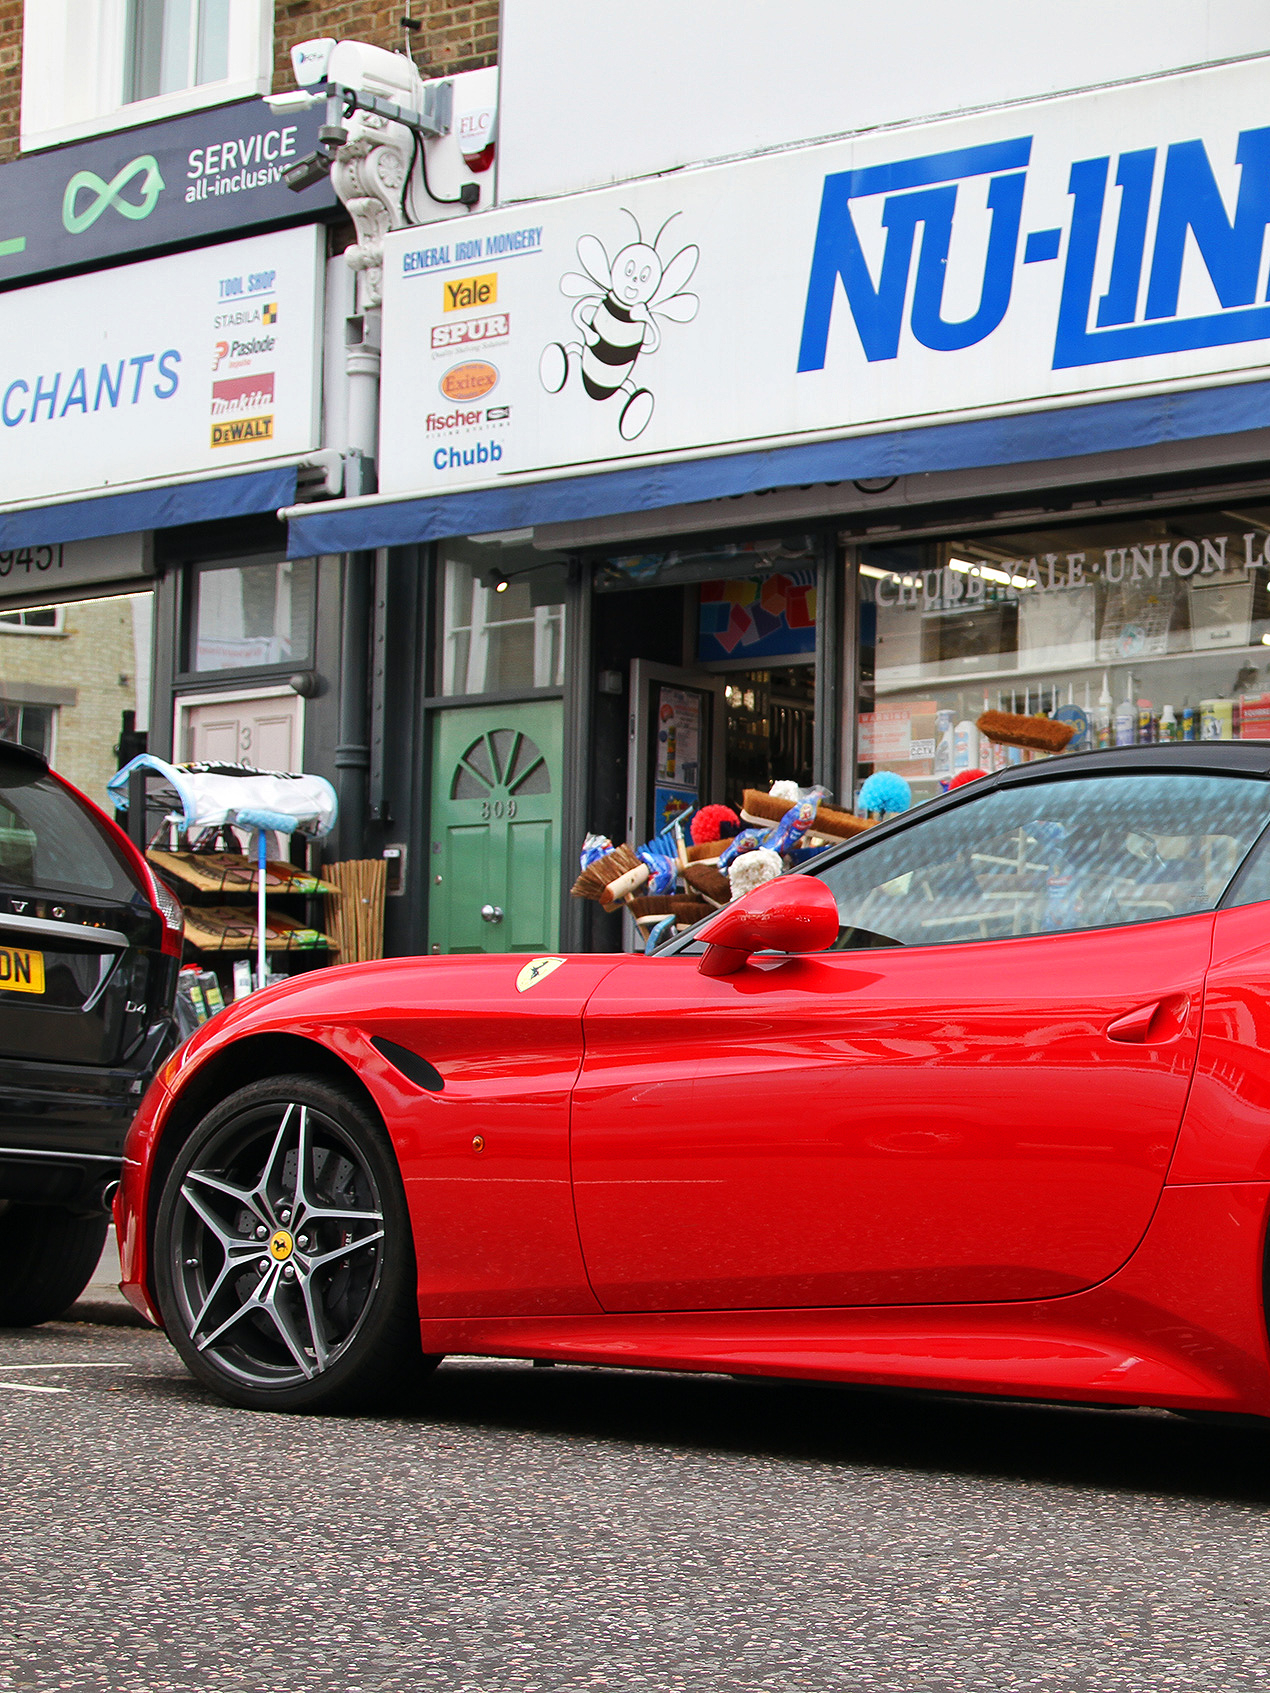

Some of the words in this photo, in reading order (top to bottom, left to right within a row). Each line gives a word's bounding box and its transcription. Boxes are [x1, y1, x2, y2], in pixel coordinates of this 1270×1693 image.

[460, 112, 489, 133] FLC
[186, 125, 298, 179] SERVICE
[403, 245, 450, 272] GENERAL
[455, 238, 483, 261] IRON
[486, 226, 543, 255] MONGERY
[447, 279, 491, 308] Yale
[214, 309, 261, 329] STABILA
[432, 314, 509, 348] SPUR
[230, 335, 276, 357] Paslode
[2, 349, 182, 427] CHANTS
[425, 409, 483, 432] fischer
[433, 439, 503, 470] Chubb
[1102, 538, 1231, 584] UNION
[481, 800, 517, 820] 309
[125, 1001, 147, 1014] D4
